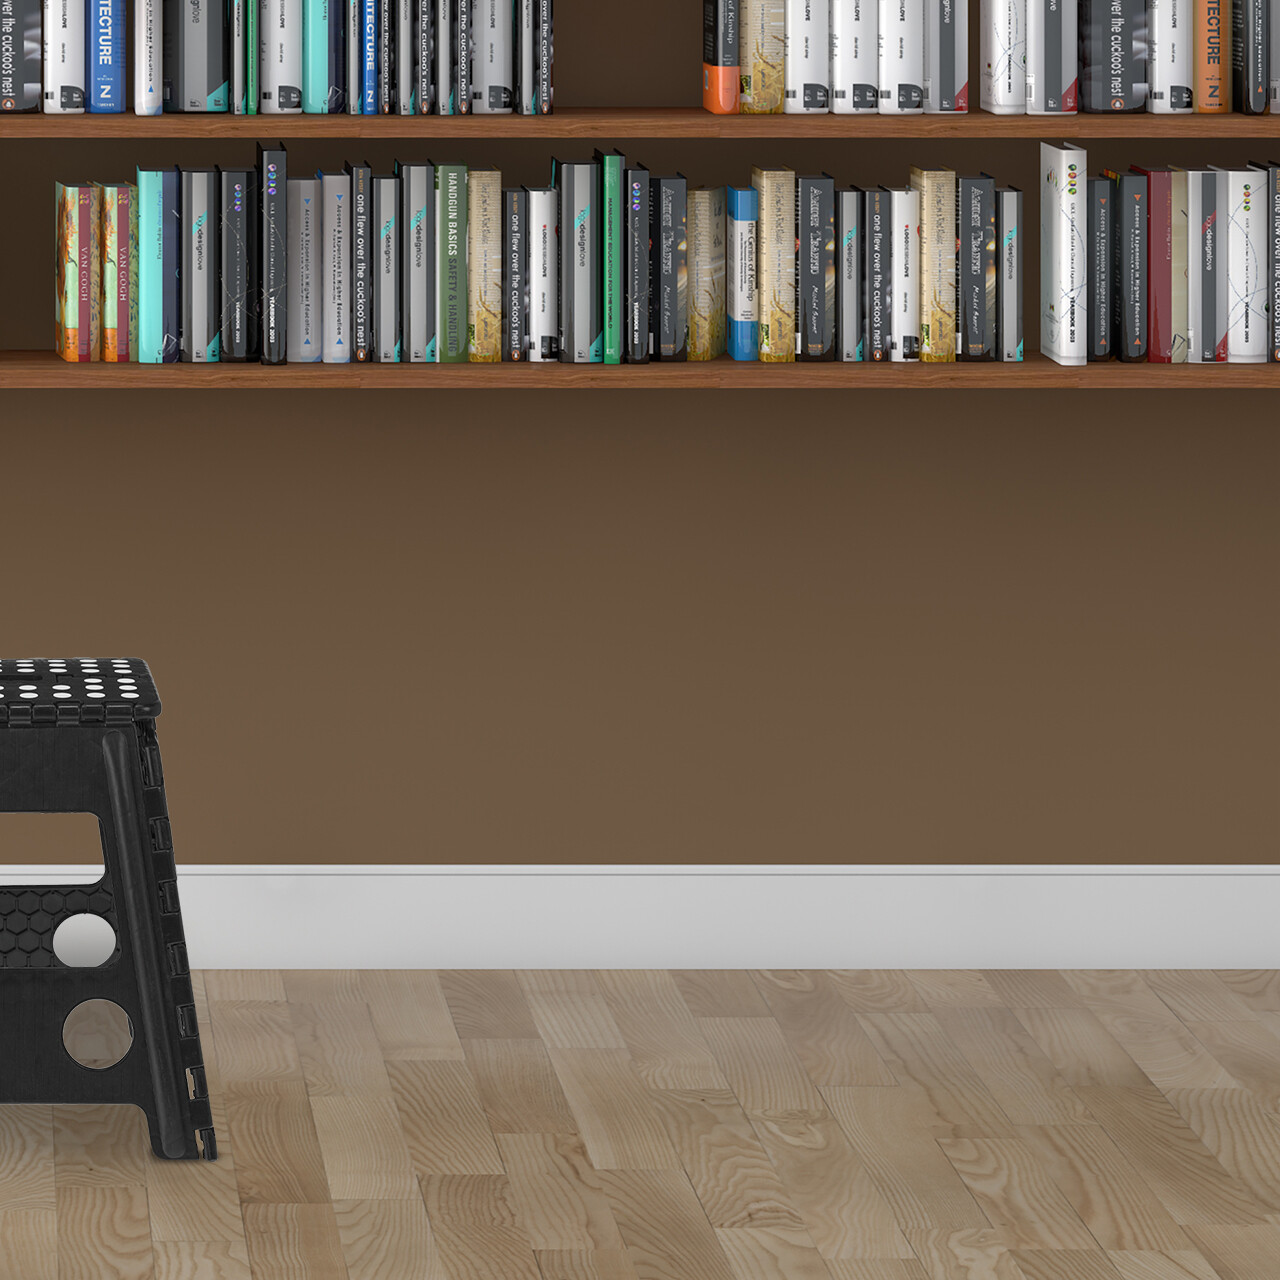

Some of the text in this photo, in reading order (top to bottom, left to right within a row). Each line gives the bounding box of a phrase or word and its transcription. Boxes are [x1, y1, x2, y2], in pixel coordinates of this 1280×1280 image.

[728, 0, 735, 9] of
[726, 12, 735, 44] Kinship
[1111, 18, 1124, 32] the
[1111, 77, 1123, 96] nest
[874, 233, 882, 250] flew
[874, 274, 882, 288] the
